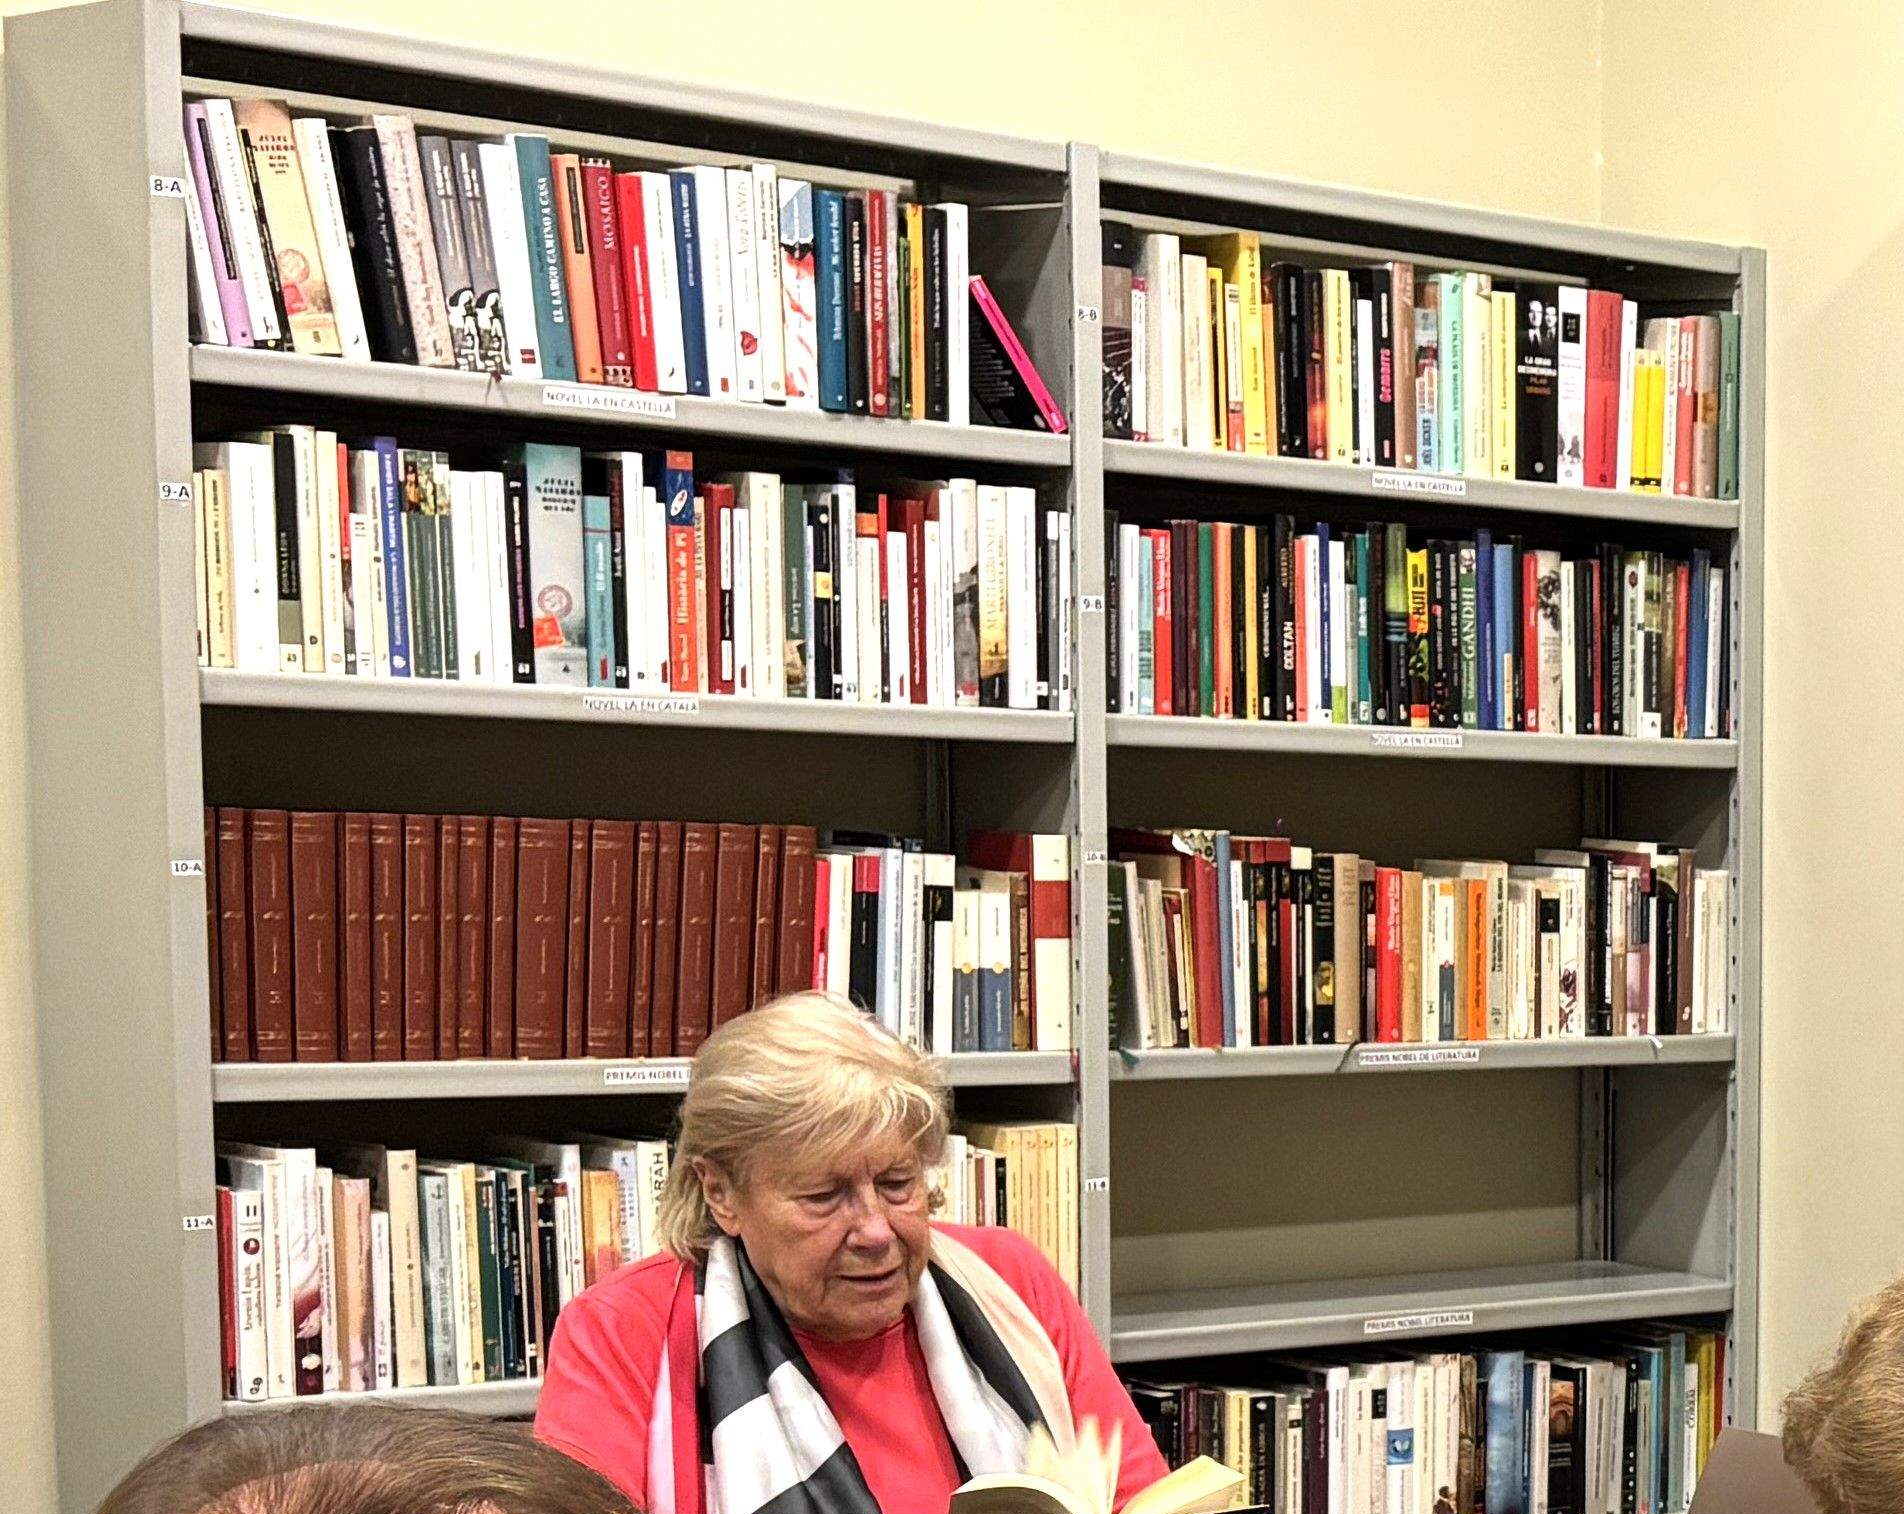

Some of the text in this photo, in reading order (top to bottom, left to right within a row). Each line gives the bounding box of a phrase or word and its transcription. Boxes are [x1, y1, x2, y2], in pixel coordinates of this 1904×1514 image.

[154, 179, 182, 193] 8-A
[595, 176, 616, 251] MOSAICO
[548, 269, 563, 308] LARGO
[552, 308, 565, 324] EL
[162, 484, 190, 498] 9-A
[1461, 586, 1477, 661] GANDHI
[1283, 620, 1295, 671] COLTAN
[174, 863, 201, 872] 10-A
[187, 1218, 213, 1227] 11-A
